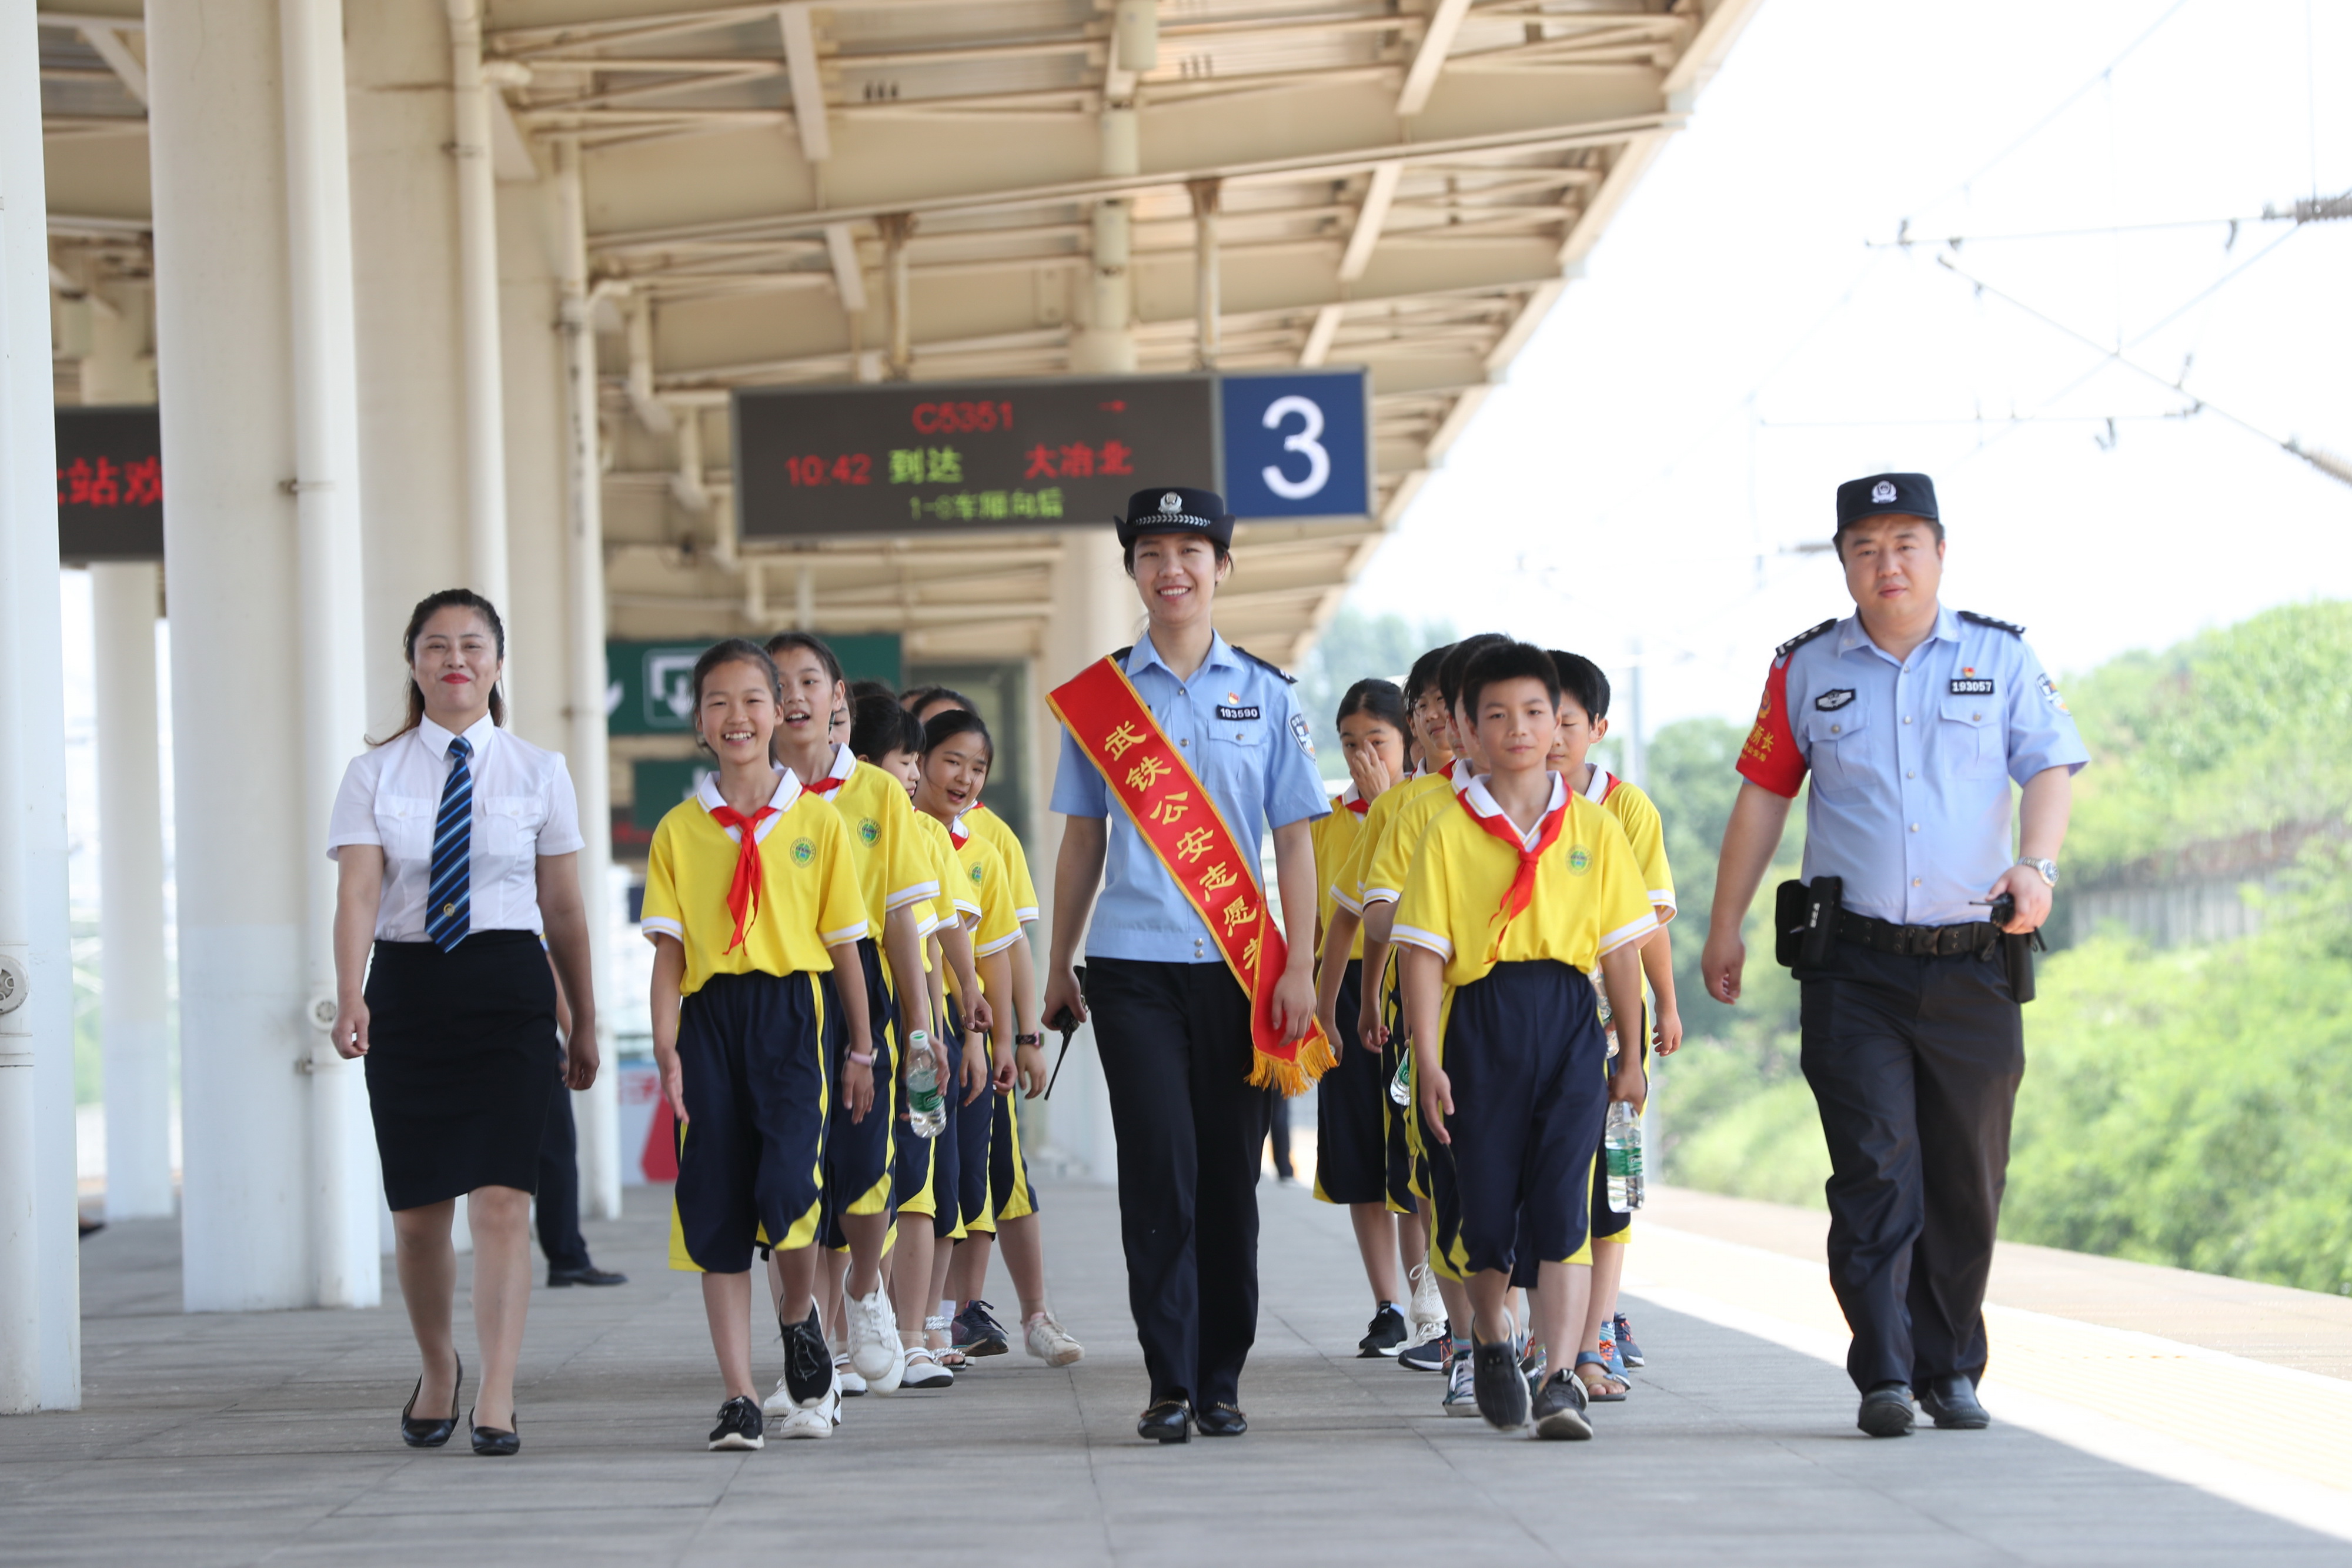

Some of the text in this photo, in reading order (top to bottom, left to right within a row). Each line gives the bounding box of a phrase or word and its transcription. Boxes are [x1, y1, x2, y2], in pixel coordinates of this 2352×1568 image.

[911, 400, 1014, 434] C5351
[785, 453, 872, 487] 10:42
[888, 445, 964, 484] 到达
[1262, 395, 1330, 500] 3
[58, 456, 162, 508] 站欢
[1952, 681, 1992, 692] 193057
